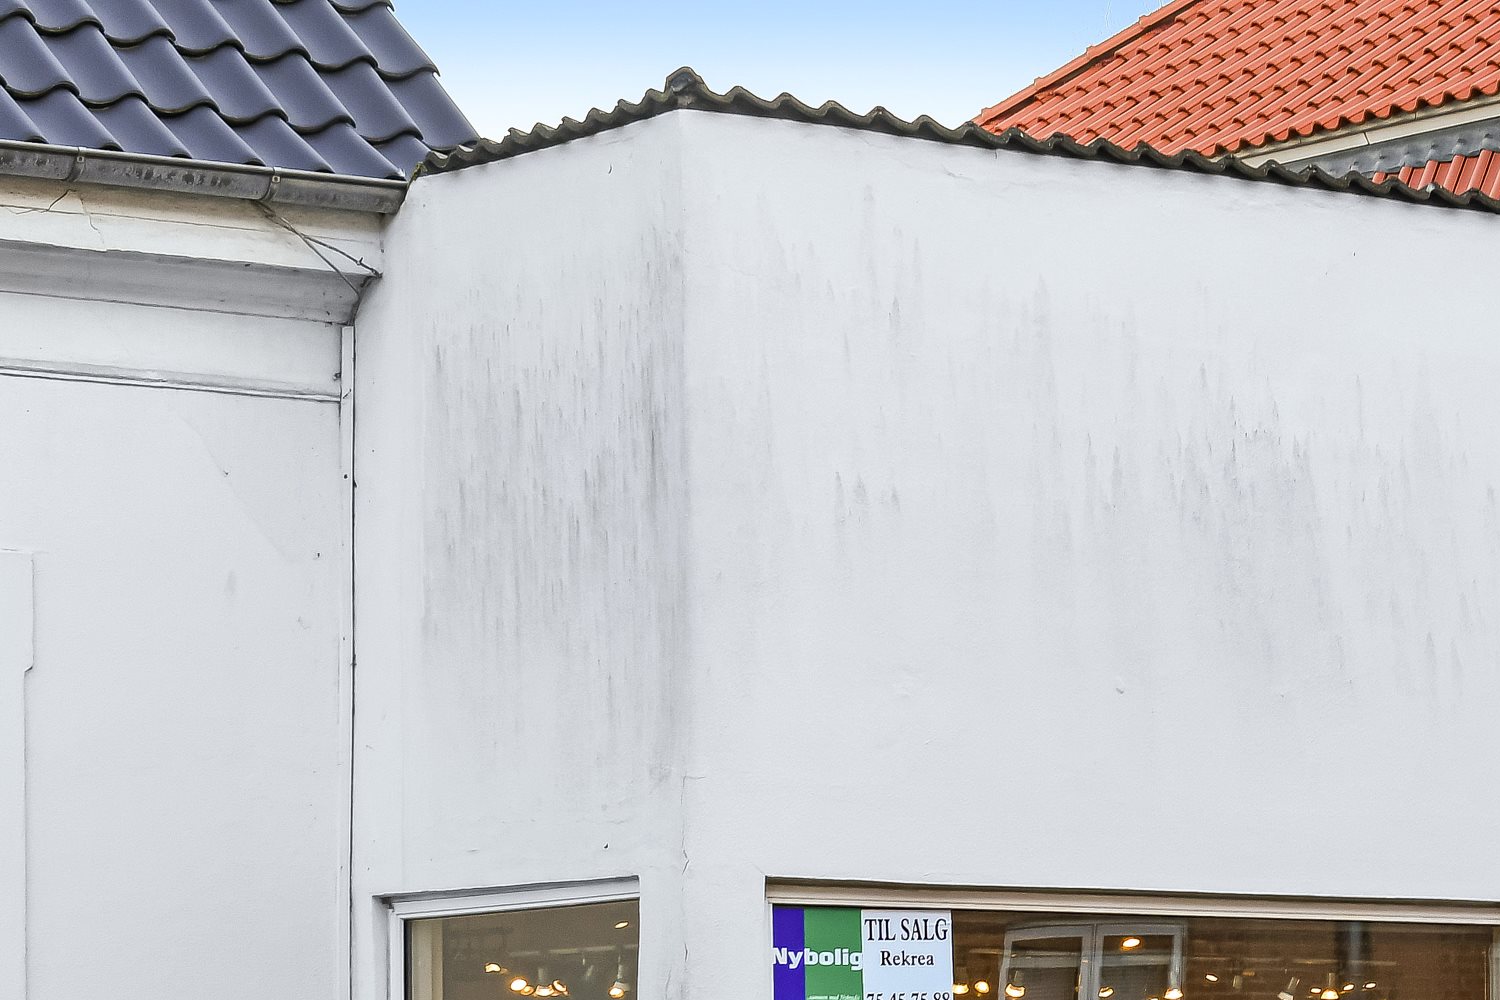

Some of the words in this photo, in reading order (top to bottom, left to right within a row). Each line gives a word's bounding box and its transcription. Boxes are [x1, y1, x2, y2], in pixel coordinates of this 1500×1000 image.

[864, 918, 897, 941] TIL
[900, 918, 948, 941] SALG
[772, 947, 863, 971] Nybolig
[880, 950, 934, 967] Rekrea
